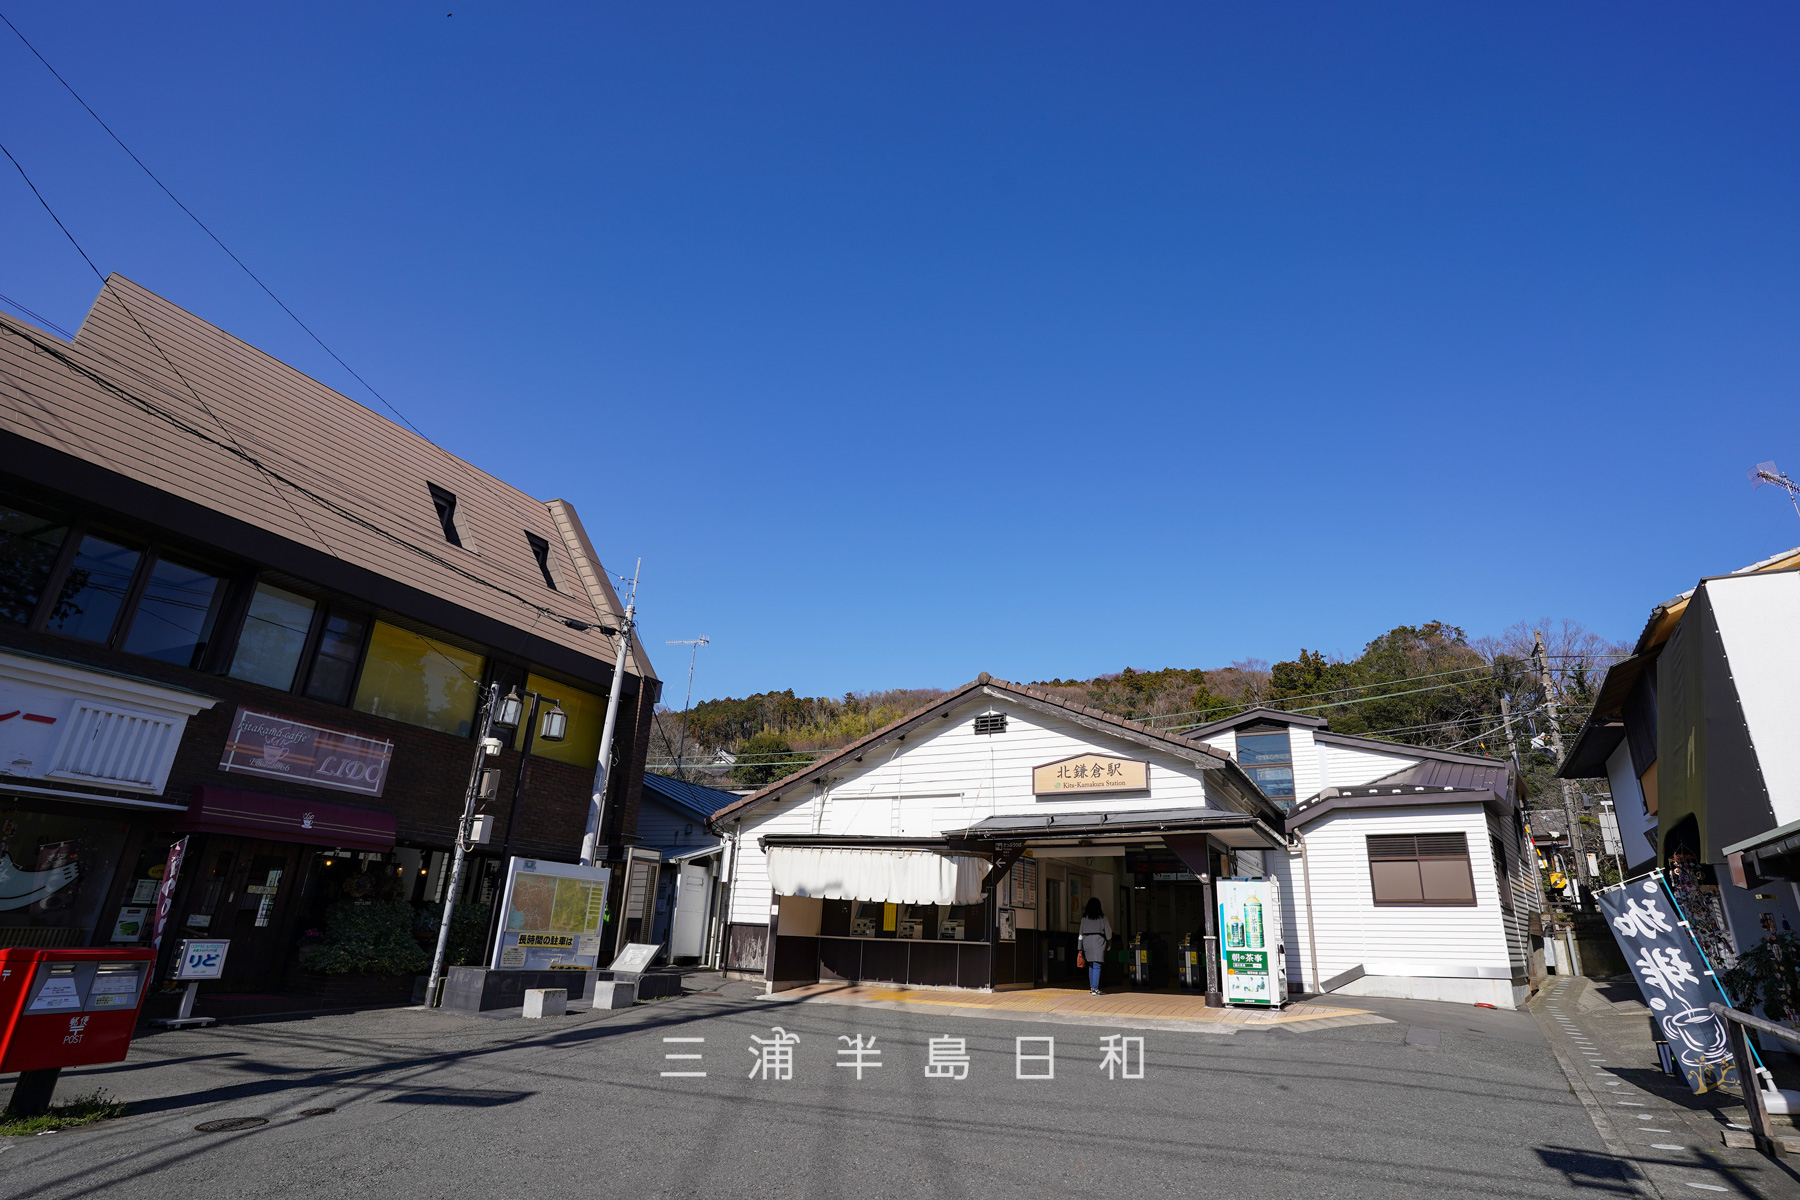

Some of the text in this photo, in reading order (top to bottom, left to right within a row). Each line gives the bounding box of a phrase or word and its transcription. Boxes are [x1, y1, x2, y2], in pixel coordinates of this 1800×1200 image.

[237, 719, 282, 738] kitakama
[316, 755, 383, 784] LIDO
[1056, 761, 1123, 779] 北鎌倉駅
[1062, 781, 1105, 789] Kita-Kamakura
[1106, 780, 1126, 788] Station
[518, 934, 574, 946] 長時間の駐車は
[189, 953, 220, 968] りど
[1231, 952, 1263, 962] 朝の茶事
[69, 1015, 90, 1027] 郵便
[63, 1034, 85, 1045] POST
